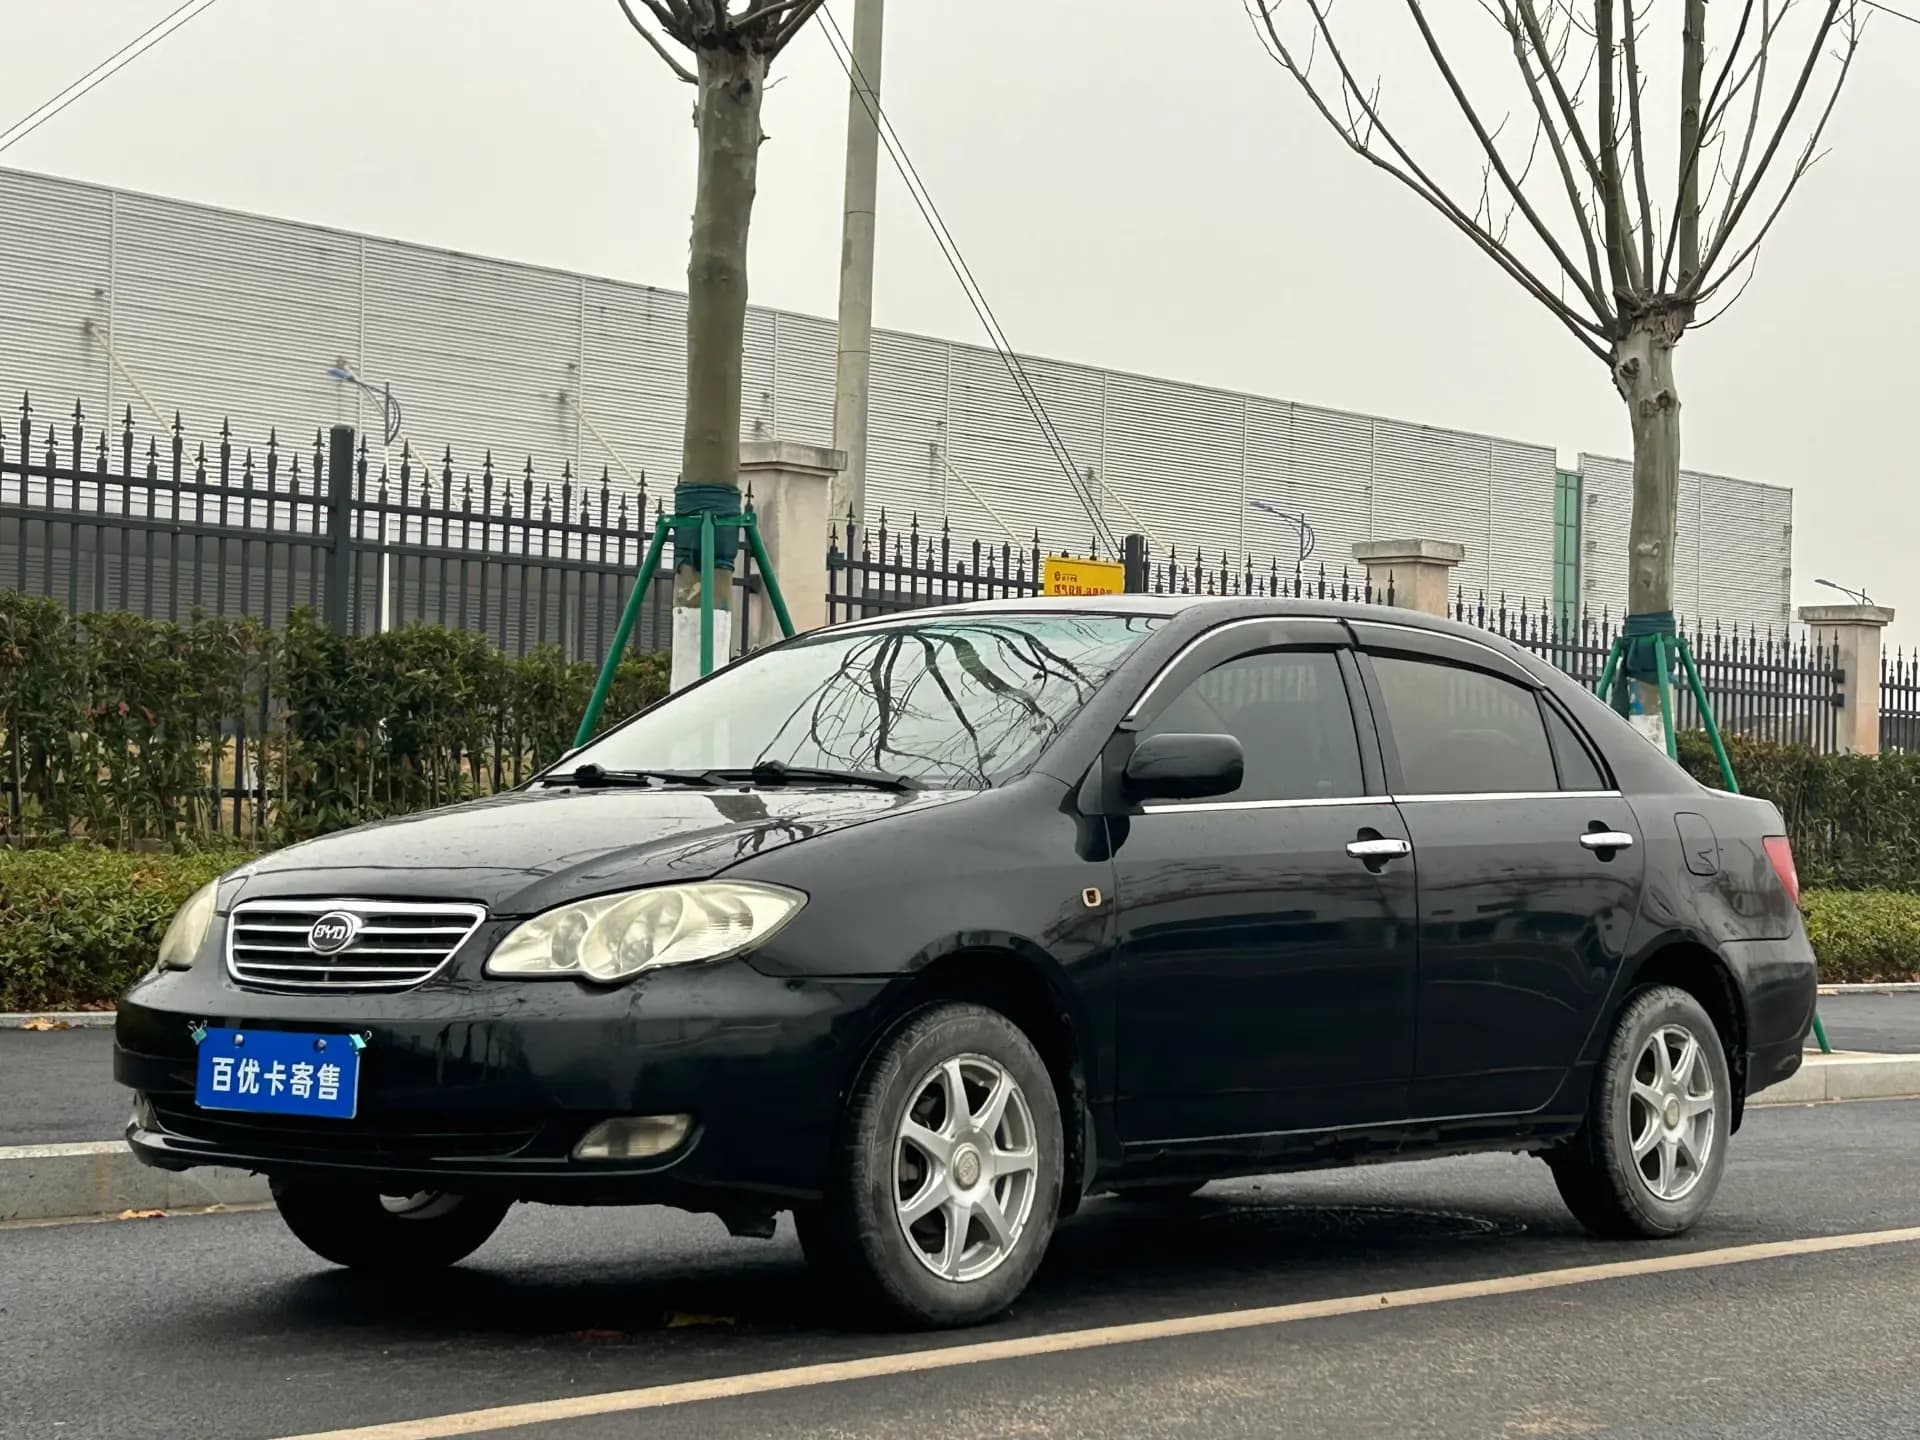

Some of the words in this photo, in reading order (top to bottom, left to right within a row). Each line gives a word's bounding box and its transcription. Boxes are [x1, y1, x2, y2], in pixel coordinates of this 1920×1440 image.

[313, 924, 347, 940] BYD
[211, 1056, 341, 1101] 百优卡寄售
